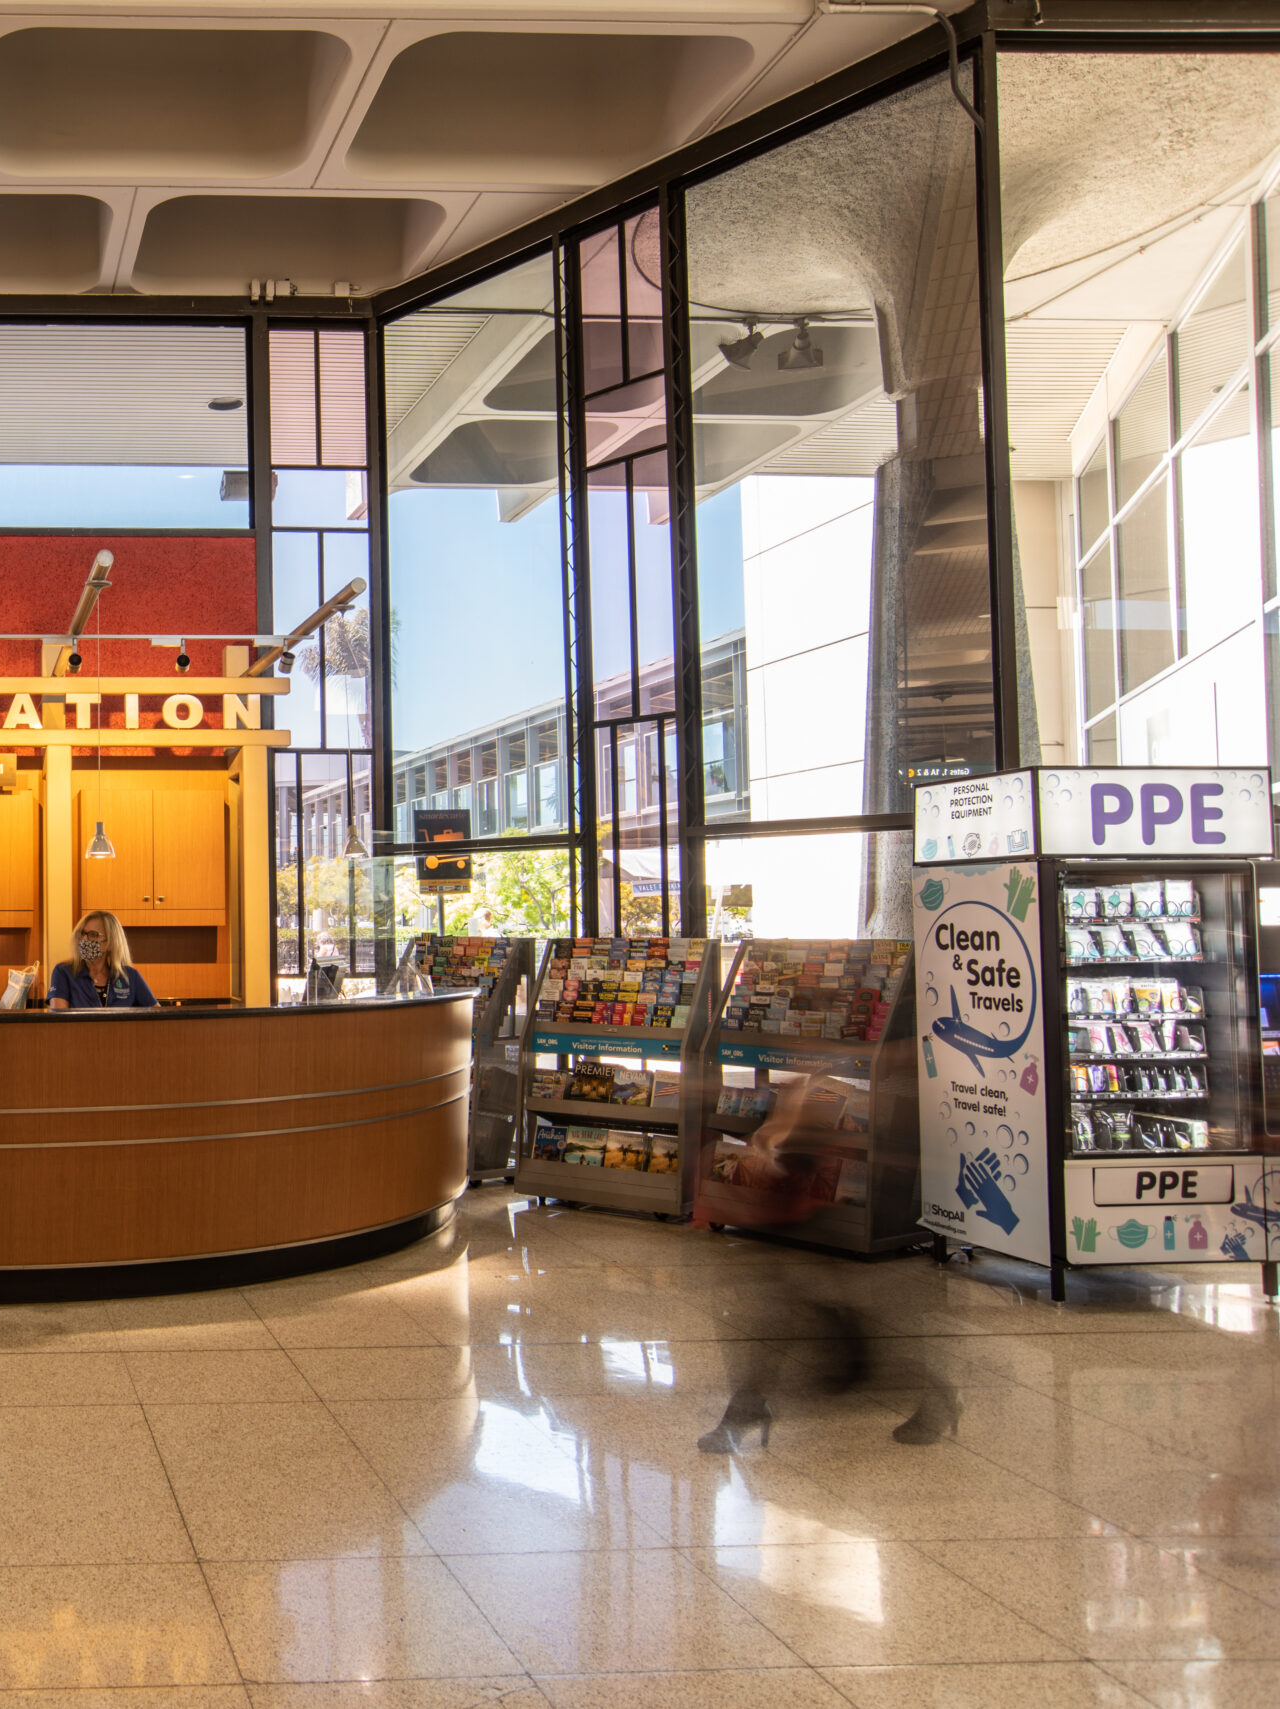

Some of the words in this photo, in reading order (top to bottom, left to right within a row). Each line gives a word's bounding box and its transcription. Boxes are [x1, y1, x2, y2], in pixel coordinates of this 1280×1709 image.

[953, 783, 990, 795] PERSONAL
[950, 794, 993, 807] PROTECTION
[951, 807, 992, 819] EQUIPMENT
[1090, 782, 1227, 846] PPE
[935, 922, 1000, 951] Clean
[952, 953, 963, 971] &
[966, 958, 1021, 988] Safe
[969, 991, 1023, 1013] Travels
[572, 1042, 596, 1050] Visitor
[598, 1043, 642, 1054] Information
[758, 1054, 784, 1064] Visitor
[786, 1056, 833, 1068] Information
[619, 1070, 646, 1081] NEVADA
[951, 1081, 977, 1095] Travel
[980, 1086, 1009, 1102] clean,
[953, 1098, 980, 1112] Travel
[983, 1104, 1007, 1117] safe!
[1136, 1170, 1198, 1200] PPE
[931, 1203, 965, 1222] ShopAll
